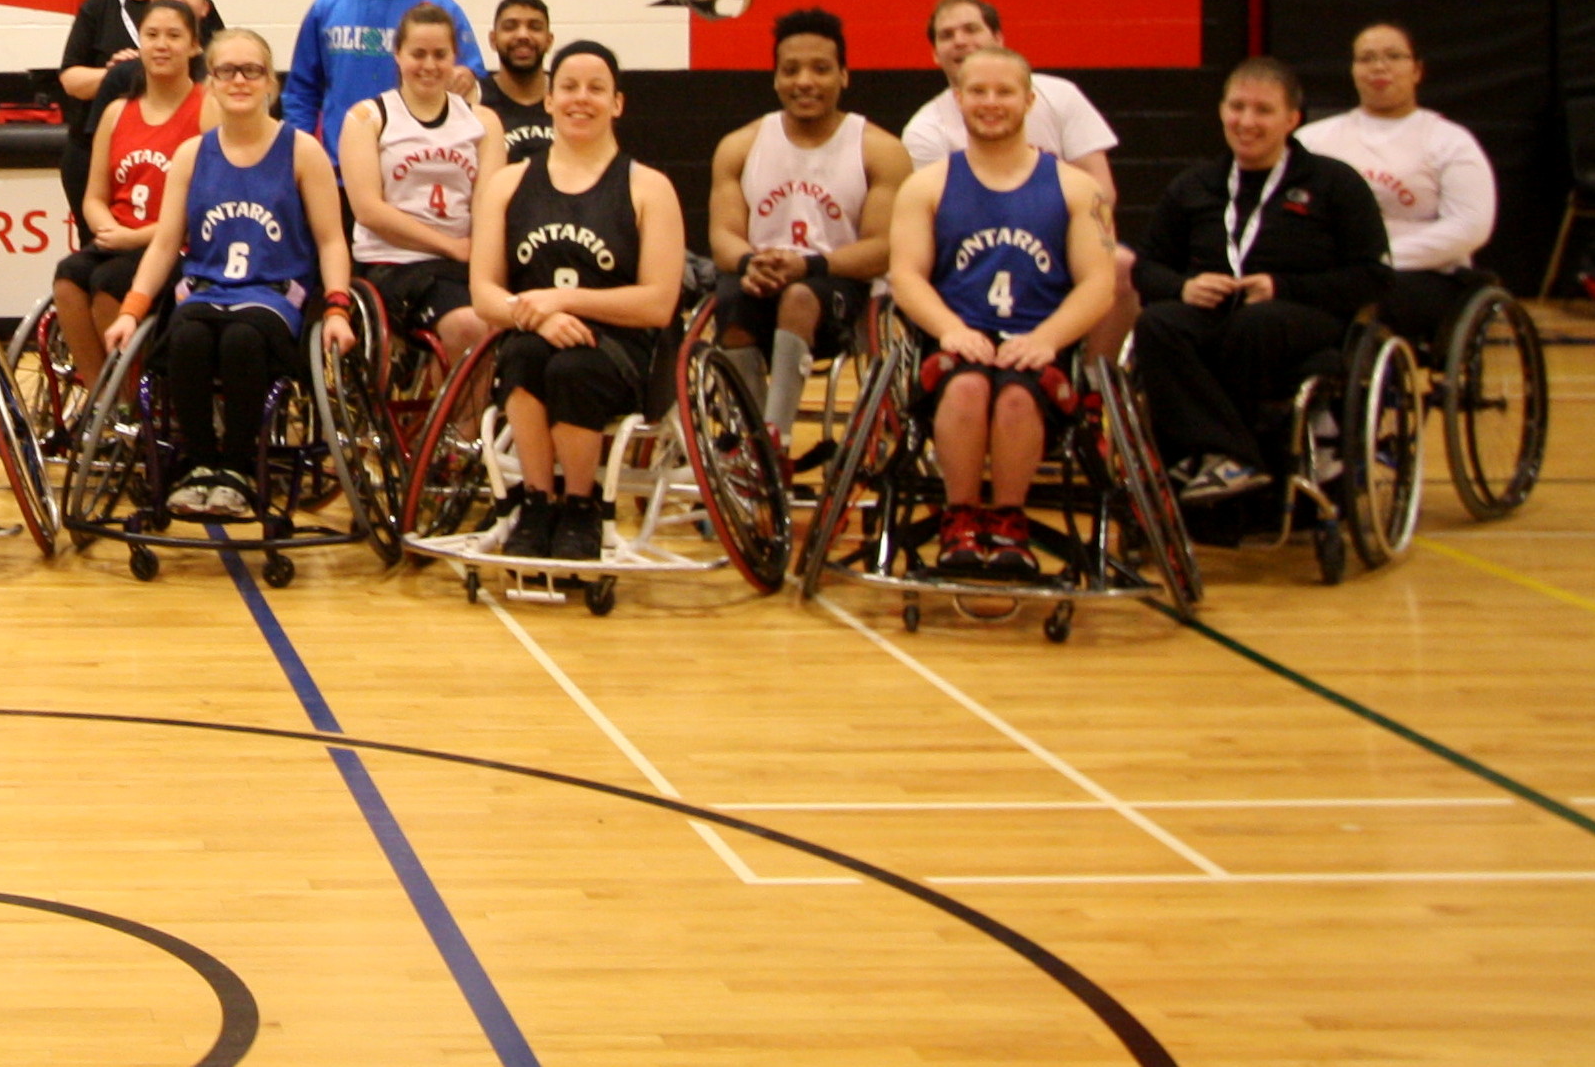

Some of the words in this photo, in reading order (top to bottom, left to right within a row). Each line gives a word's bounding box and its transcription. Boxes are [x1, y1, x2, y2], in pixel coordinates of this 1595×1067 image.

[114, 149, 172, 184] ONTARI
[200, 200, 282, 243] ONTARIO
[429, 183, 447, 218] 4
[757, 180, 842, 221] ONTARIO
[223, 241, 250, 280] 6
[516, 222, 615, 271] ONTARIO
[955, 226, 1052, 275] ONTARIO
[986, 270, 1014, 318] 4
